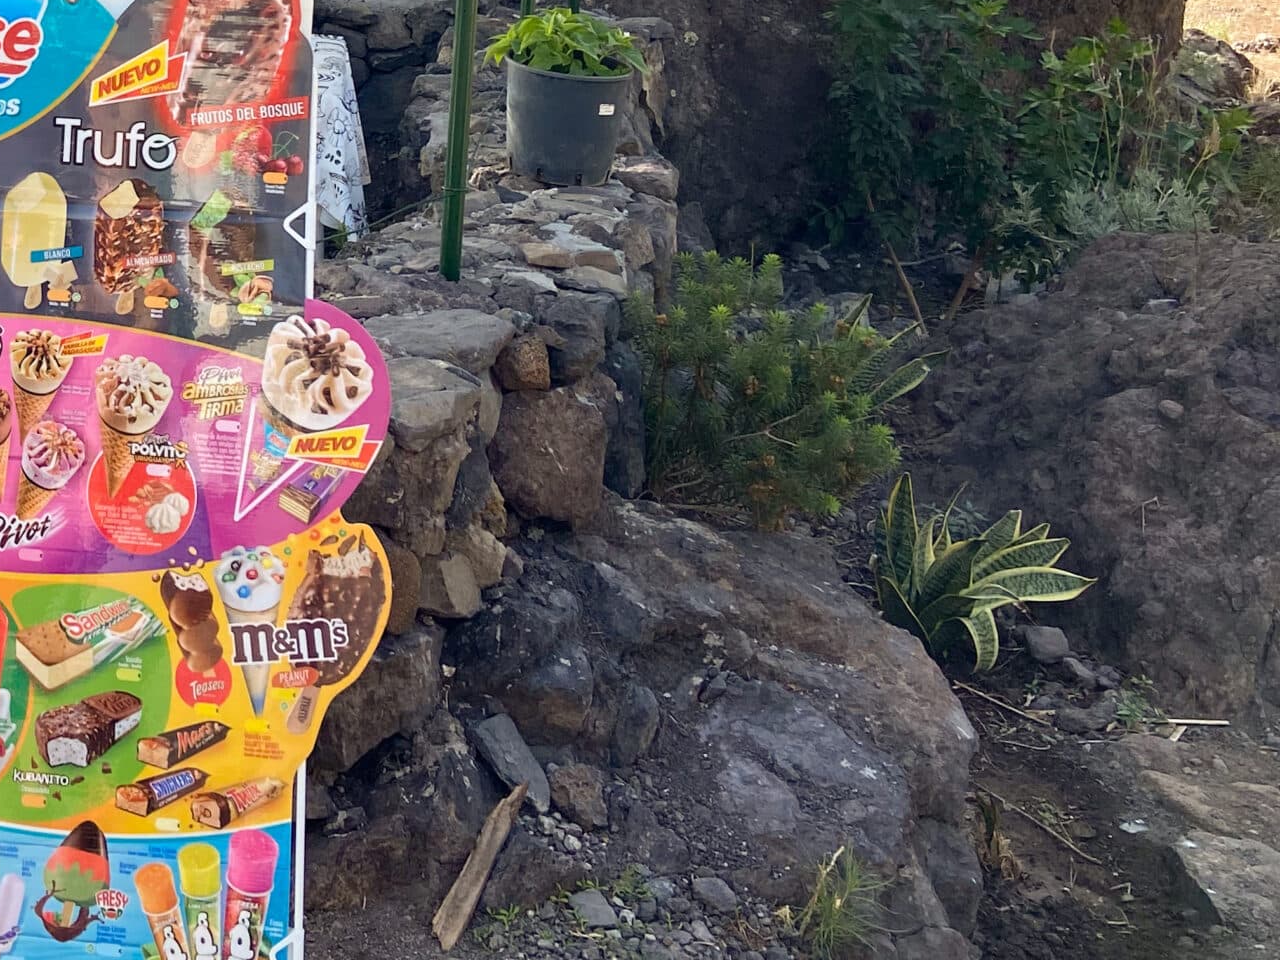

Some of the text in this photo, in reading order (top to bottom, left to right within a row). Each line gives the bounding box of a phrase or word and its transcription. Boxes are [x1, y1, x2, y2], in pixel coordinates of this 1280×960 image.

[97, 57, 161, 98] NUEVO
[191, 102, 305, 126] FRUTOS DEL BOSQUE
[55, 117, 178, 170] Trufo
[43, 248, 71, 260] BLANCO
[125, 253, 173, 267] ALMENDRADO
[295, 436, 357, 453] NUEVO
[279, 670, 310, 684] PEANUT
[13, 768, 69, 785] KUBANITO
[152, 771, 194, 799] SNICKERS
[96, 890, 128, 907] FRESY
